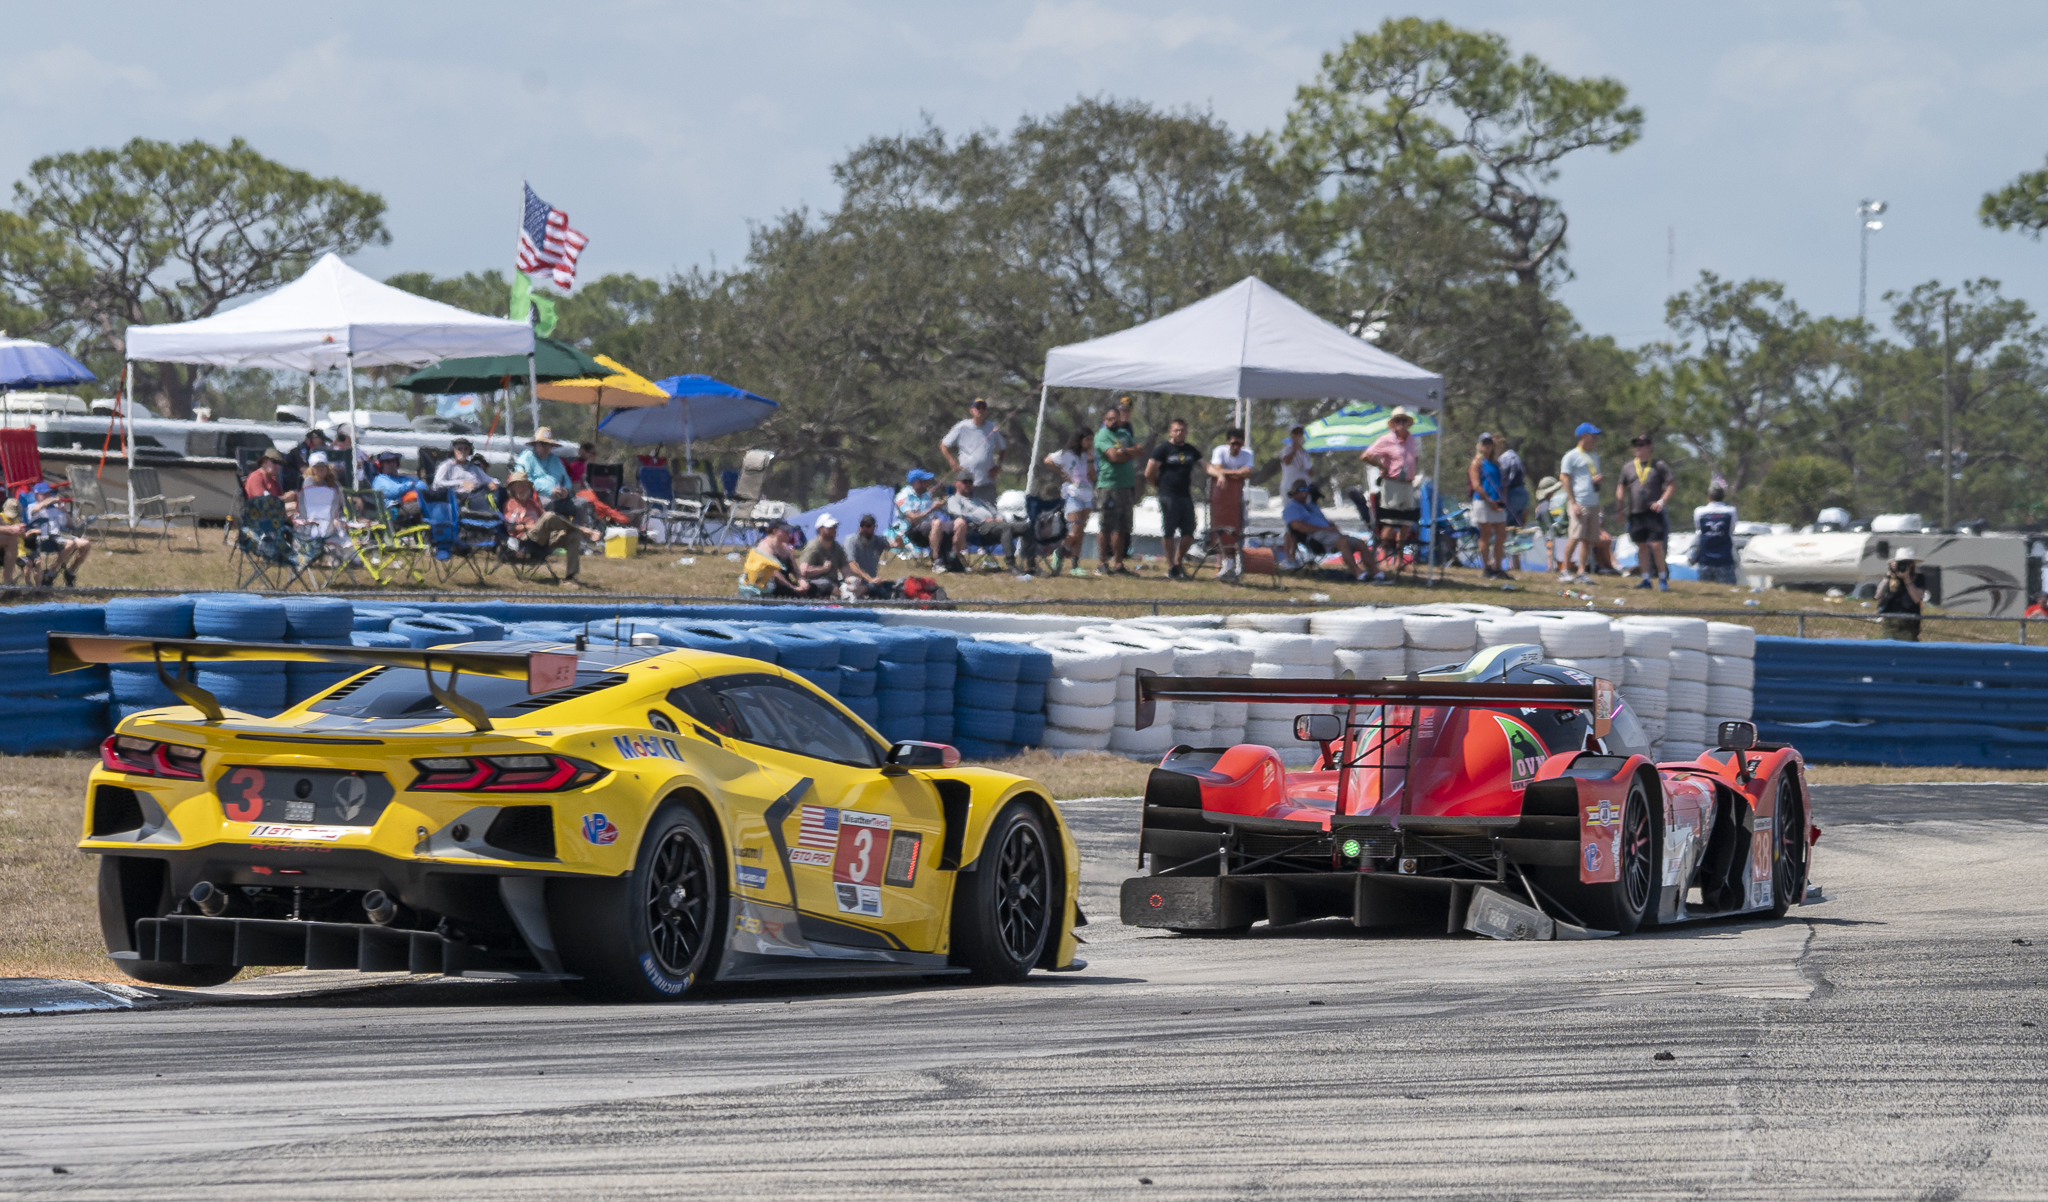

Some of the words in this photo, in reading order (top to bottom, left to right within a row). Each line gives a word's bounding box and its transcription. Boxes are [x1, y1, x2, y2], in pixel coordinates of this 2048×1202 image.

[612, 733, 669, 760] Mobil
[661, 737, 686, 763] 1
[225, 767, 266, 822] 3
[582, 812, 607, 845] VP
[843, 814, 889, 828] WeatherTech
[792, 850, 811, 862] GTD
[811, 852, 832, 864] PRO
[849, 829, 873, 883] 3
[1755, 832, 1771, 879] 38
[642, 957, 683, 994] MICHELIN
